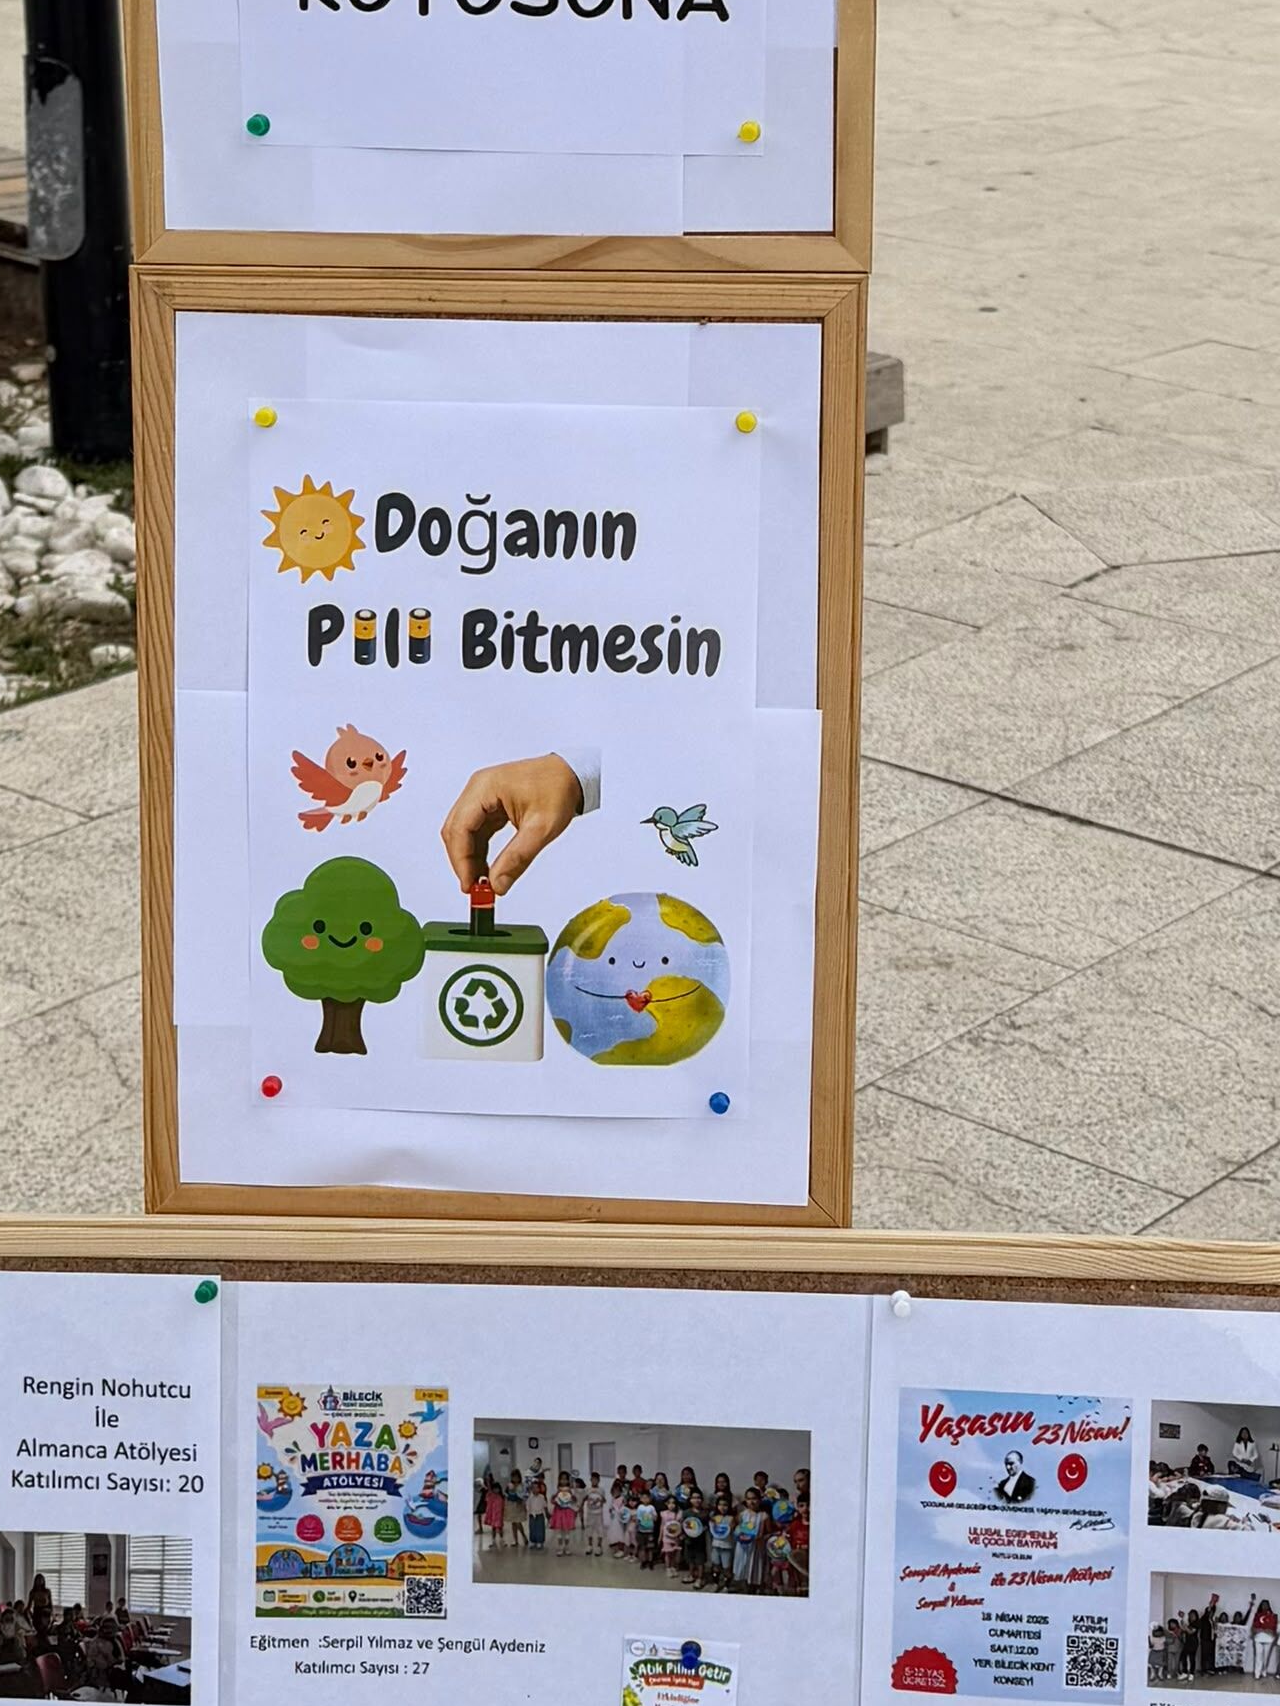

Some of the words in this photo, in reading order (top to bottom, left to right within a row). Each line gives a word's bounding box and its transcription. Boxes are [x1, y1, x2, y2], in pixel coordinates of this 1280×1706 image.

[375, 493, 637, 574] Doğanın
[462, 609, 722, 677] Bitmesin
[23, 1376, 94, 1399] Rengin
[102, 1378, 191, 1399] Nohutcu
[95, 1406, 119, 1428] İle
[919, 1403, 1036, 1446] Yaşasın
[1032, 1424, 1062, 1445] 23
[1060, 1416, 1131, 1445] Nisan!
[310, 1421, 397, 1450] YAZA
[17, 1438, 107, 1459] Almanca
[114, 1442, 197, 1465] Atölyesi
[300, 1451, 403, 1474] MERHABA
[11, 1469, 100, 1490] Katılımcı
[107, 1473, 171, 1495] Sayısı:
[178, 1475, 204, 1493] 20
[323, 1475, 384, 1489] ATÖLYESİ
[969, 1527, 1002, 1538] ULUSAL
[1005, 1529, 1058, 1540] EGEMENLİK
[969, 1537, 980, 1545] VE
[982, 1538, 1014, 1548] ÇOCUK
[1016, 1539, 1058, 1549] BAYRAMI
[900, 1564, 941, 1582] Şengül
[1008, 1572, 1027, 1585] 23
[1026, 1570, 1063, 1586] Nisan
[1064, 1566, 1114, 1585] Atölyesi
[995, 1611, 1023, 1624] NİSAN
[1072, 1615, 1108, 1625] KATILIM
[988, 1628, 1042, 1640] CUMARTESİ
[1074, 1624, 1107, 1634] FORMU
[250, 1635, 309, 1651] Eğitmen
[368, 1636, 413, 1650] Yılmaz
[416, 1640, 433, 1650] ve
[437, 1637, 485, 1653] Şengül
[490, 1639, 546, 1654] Aydeniz
[295, 1662, 355, 1675] Katılımcı
[360, 1662, 399, 1676] Sayısı
[412, 1662, 430, 1675] 27
[699, 1664, 730, 1681] Getir
[995, 1658, 1029, 1669] BİLECİK
[1030, 1661, 1055, 1672] KENT
[993, 1674, 1033, 1686] KONSEYİ
